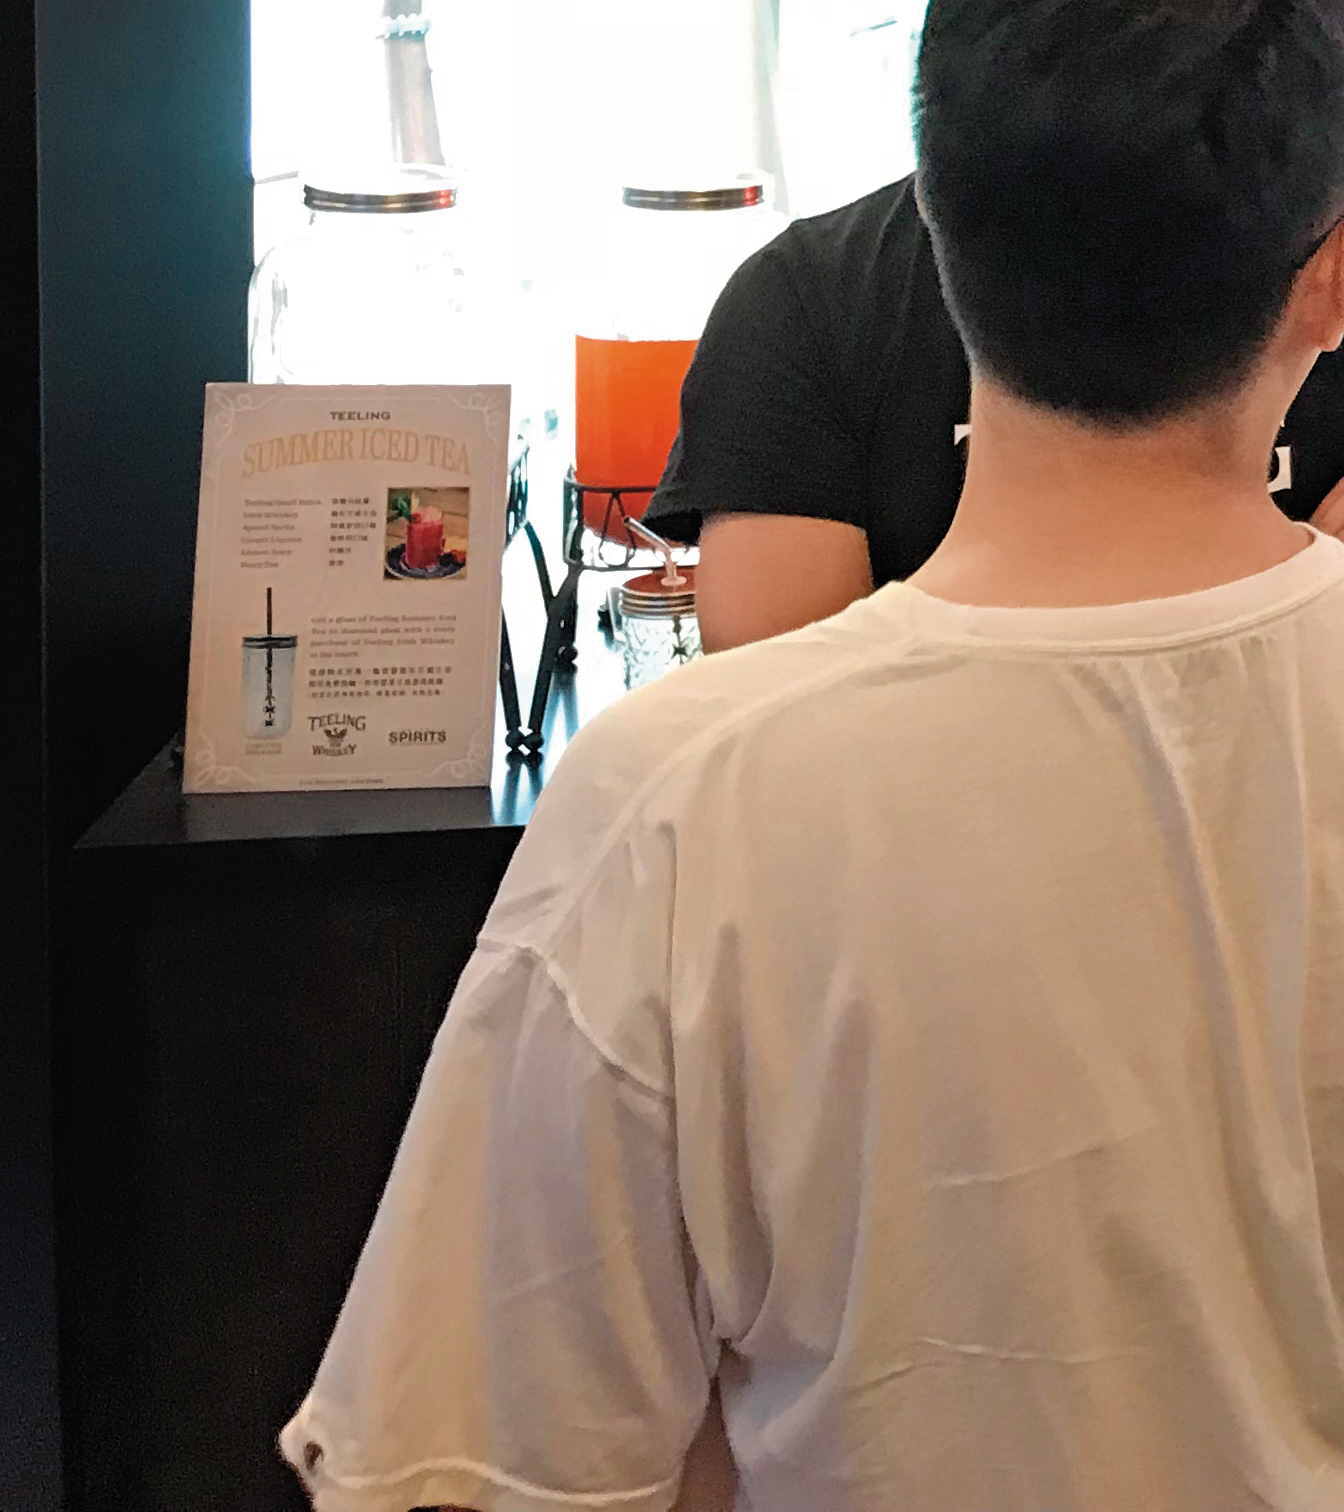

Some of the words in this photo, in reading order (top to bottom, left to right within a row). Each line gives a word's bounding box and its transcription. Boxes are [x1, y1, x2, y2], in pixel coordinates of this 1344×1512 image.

[329, 411, 391, 420] TEELING
[242, 429, 354, 477] SUMMER
[359, 428, 420, 463] ICED
[424, 434, 471, 475] TEA
[307, 713, 366, 732] TEELING
[388, 730, 446, 744] SPIRITS
